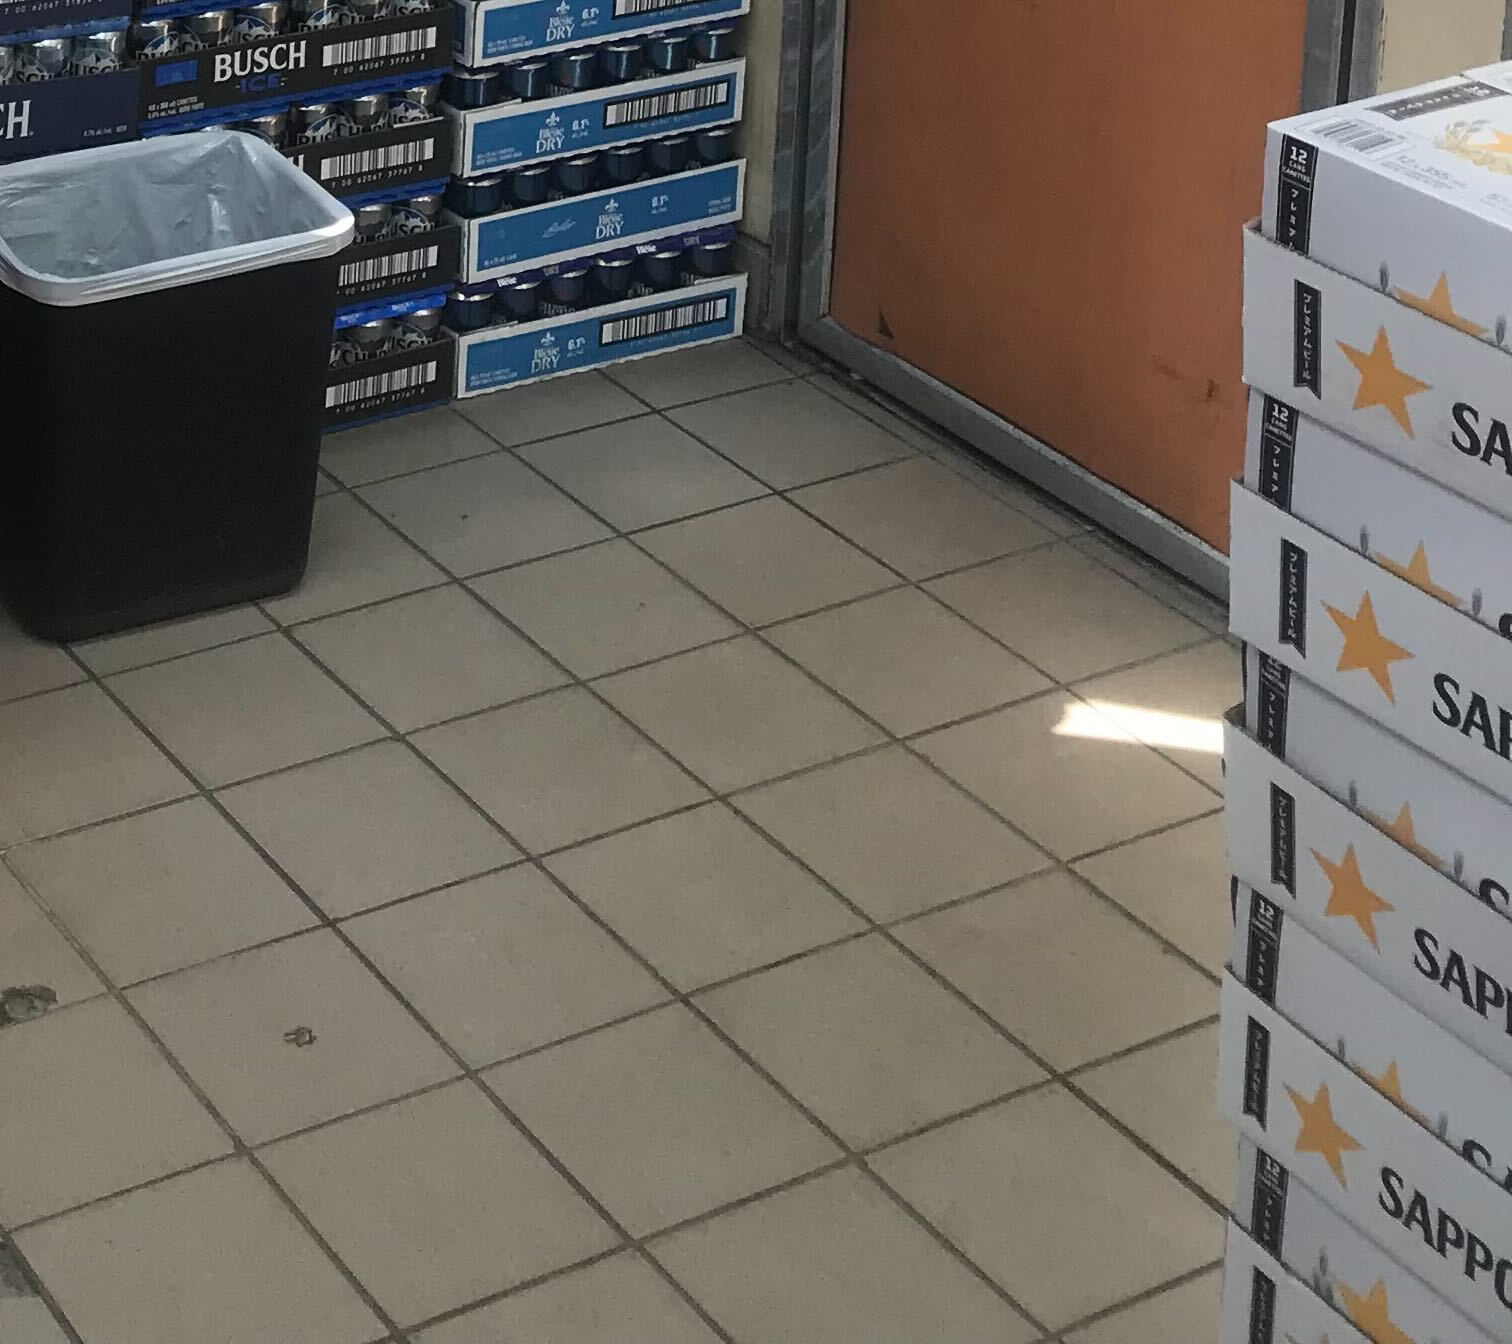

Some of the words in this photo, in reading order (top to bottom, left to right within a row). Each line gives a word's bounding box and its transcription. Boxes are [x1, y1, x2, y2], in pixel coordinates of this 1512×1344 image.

[213, 40, 308, 85] BUSCH
[1290, 145, 1308, 164] 12
[531, 355, 561, 374] DRY
